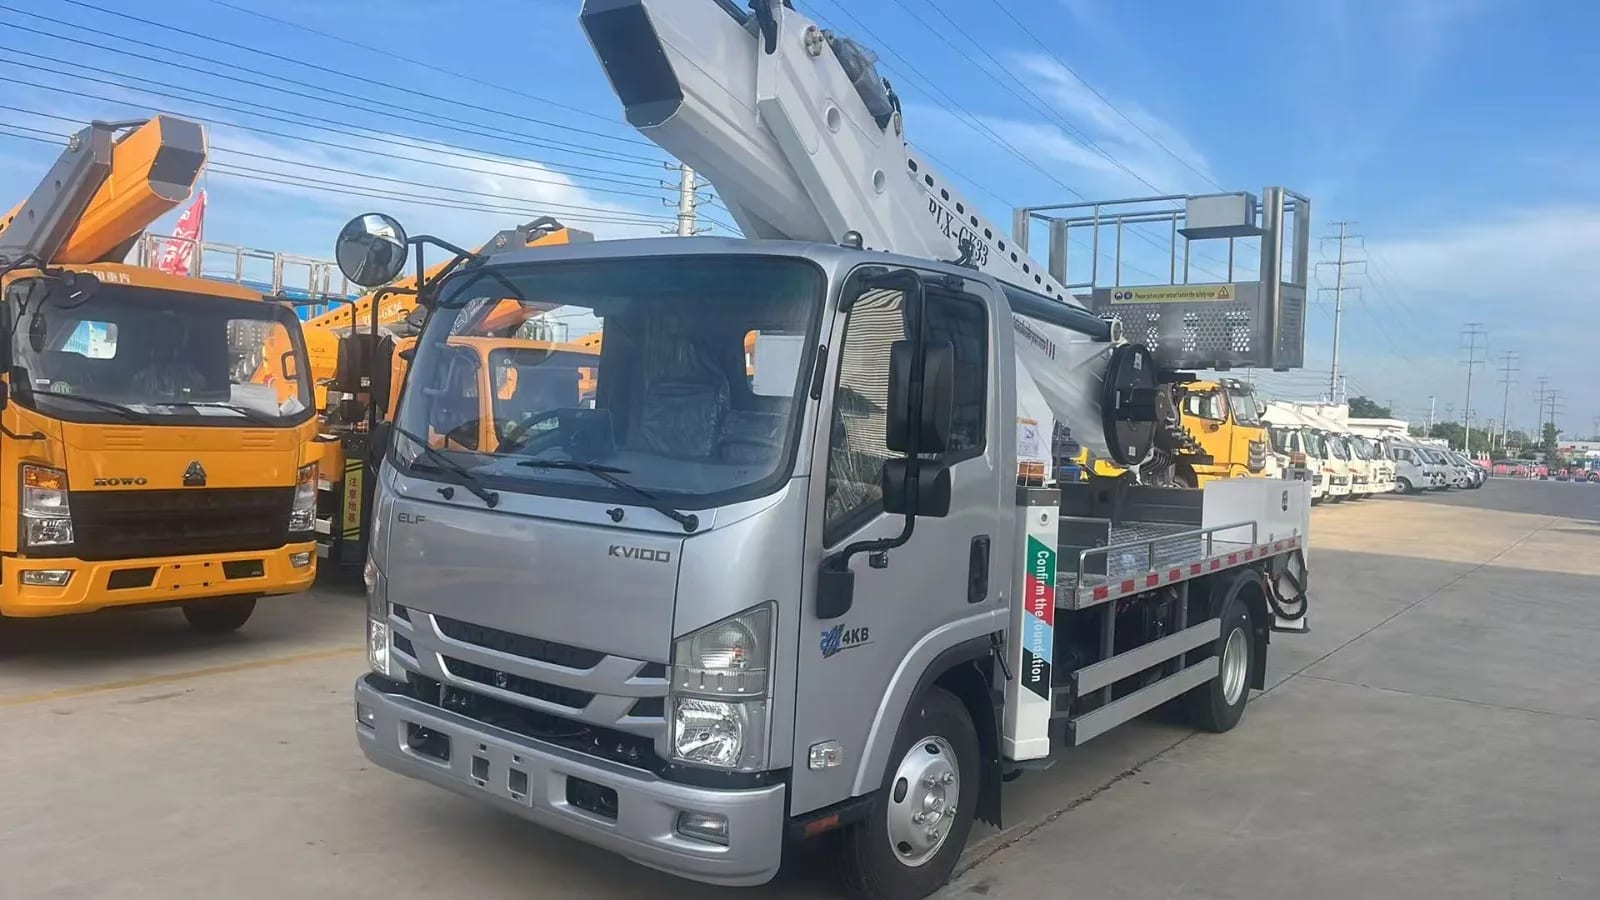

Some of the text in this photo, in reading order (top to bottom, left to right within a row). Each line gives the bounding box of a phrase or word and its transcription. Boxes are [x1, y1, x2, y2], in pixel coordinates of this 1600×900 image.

[94, 477, 148, 487] HOWO
[398, 512, 426, 524] ELF
[608, 544, 671, 563] KV100
[1031, 550, 1050, 682] Confirm the foundation
[842, 627, 869, 645] 4KB
